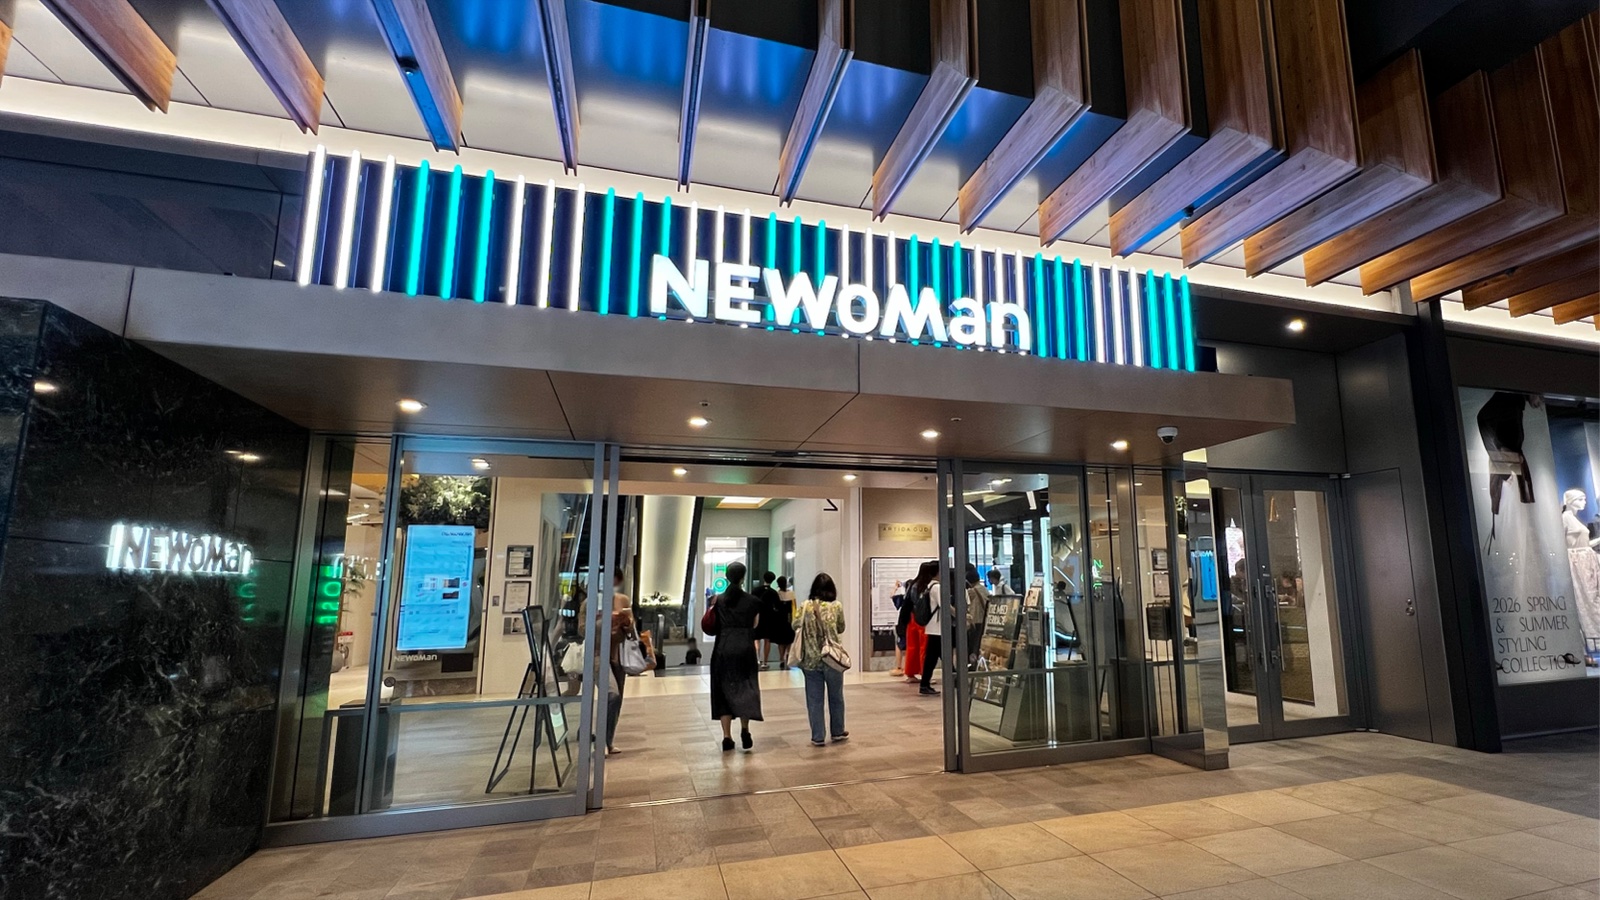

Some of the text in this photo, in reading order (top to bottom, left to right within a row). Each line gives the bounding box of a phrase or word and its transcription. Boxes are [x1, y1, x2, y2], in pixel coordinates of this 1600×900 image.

[1493, 596, 1567, 613] 2026 SPRING
[1496, 615, 1569, 633] & SUMMER
[1498, 636, 1547, 653] STYLING
